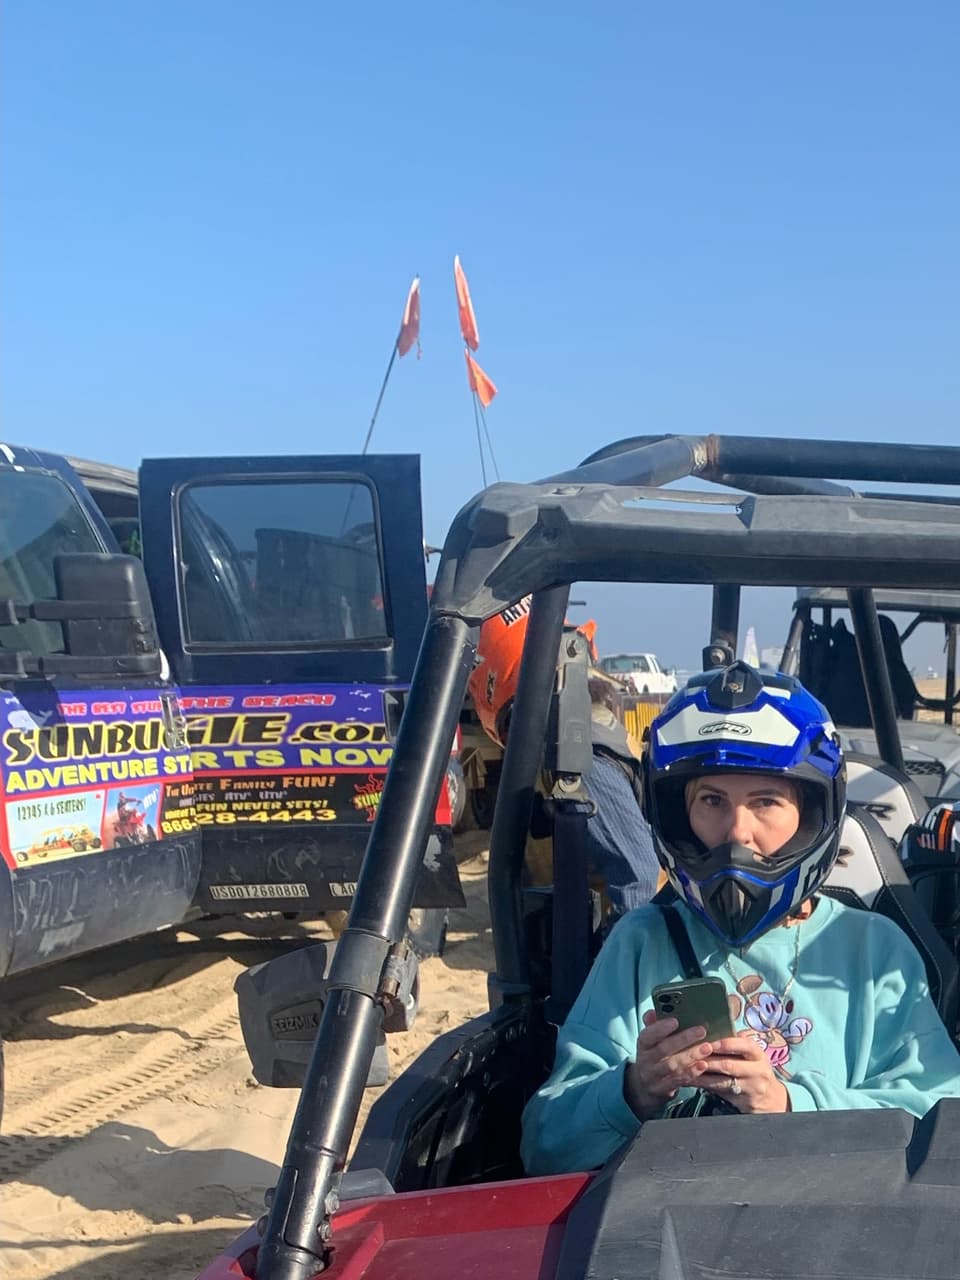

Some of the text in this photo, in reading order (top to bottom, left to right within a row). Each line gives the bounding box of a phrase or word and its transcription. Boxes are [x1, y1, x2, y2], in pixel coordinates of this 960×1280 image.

[59, 702, 87, 716] THE
[91, 701, 127, 715] BEST
[131, 701, 163, 715] STU
[242, 694, 336, 708] BEACH
[6, 757, 158, 793] ADVENTURE
[282, 776, 336, 788] FUN!
[196, 802, 228, 812] FUN
[232, 801, 282, 811] NEVER
[286, 799, 329, 810] SETS!
[161, 808, 337, 834] 866-28-4443
[273, 1013, 318, 1033] SEIZMIK
